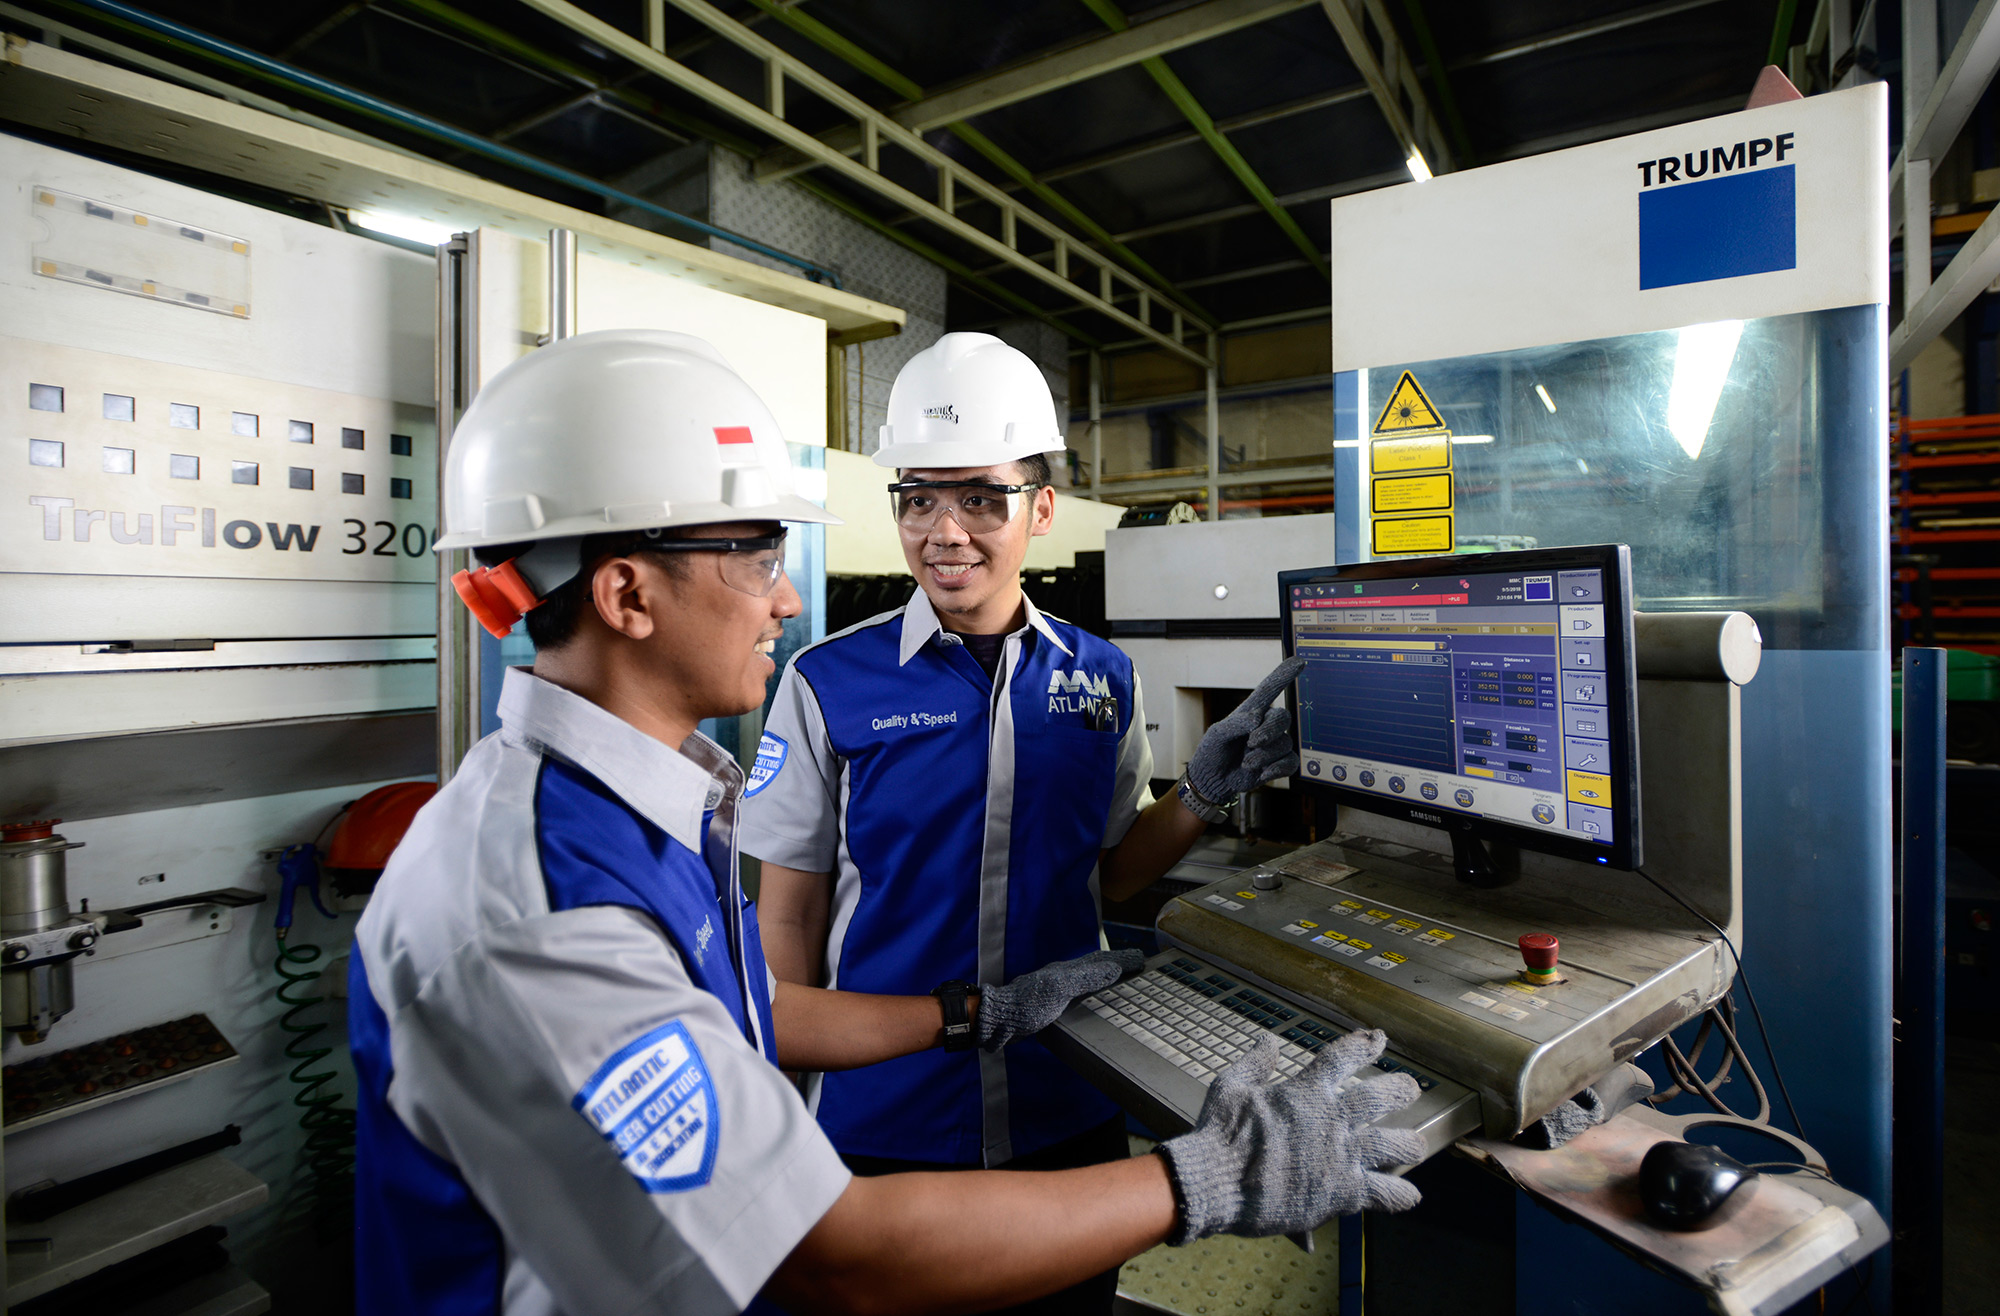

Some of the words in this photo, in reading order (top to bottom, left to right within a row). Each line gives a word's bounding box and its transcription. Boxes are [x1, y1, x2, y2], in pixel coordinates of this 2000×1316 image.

[1638, 132, 1794, 187] TRUMPF
[29, 495, 321, 552] TruFlow
[872, 714, 908, 731] Quality
[910, 713, 920, 726] &
[923, 710, 957, 727] Speed
[1572, 706, 1599, 714] Technology
[1574, 773, 1603, 781] Diagnostics
[1410, 810, 1442, 824] SAMSUNG
[616, 1118, 648, 1151] SER
[643, 1066, 702, 1125] CUTTING
